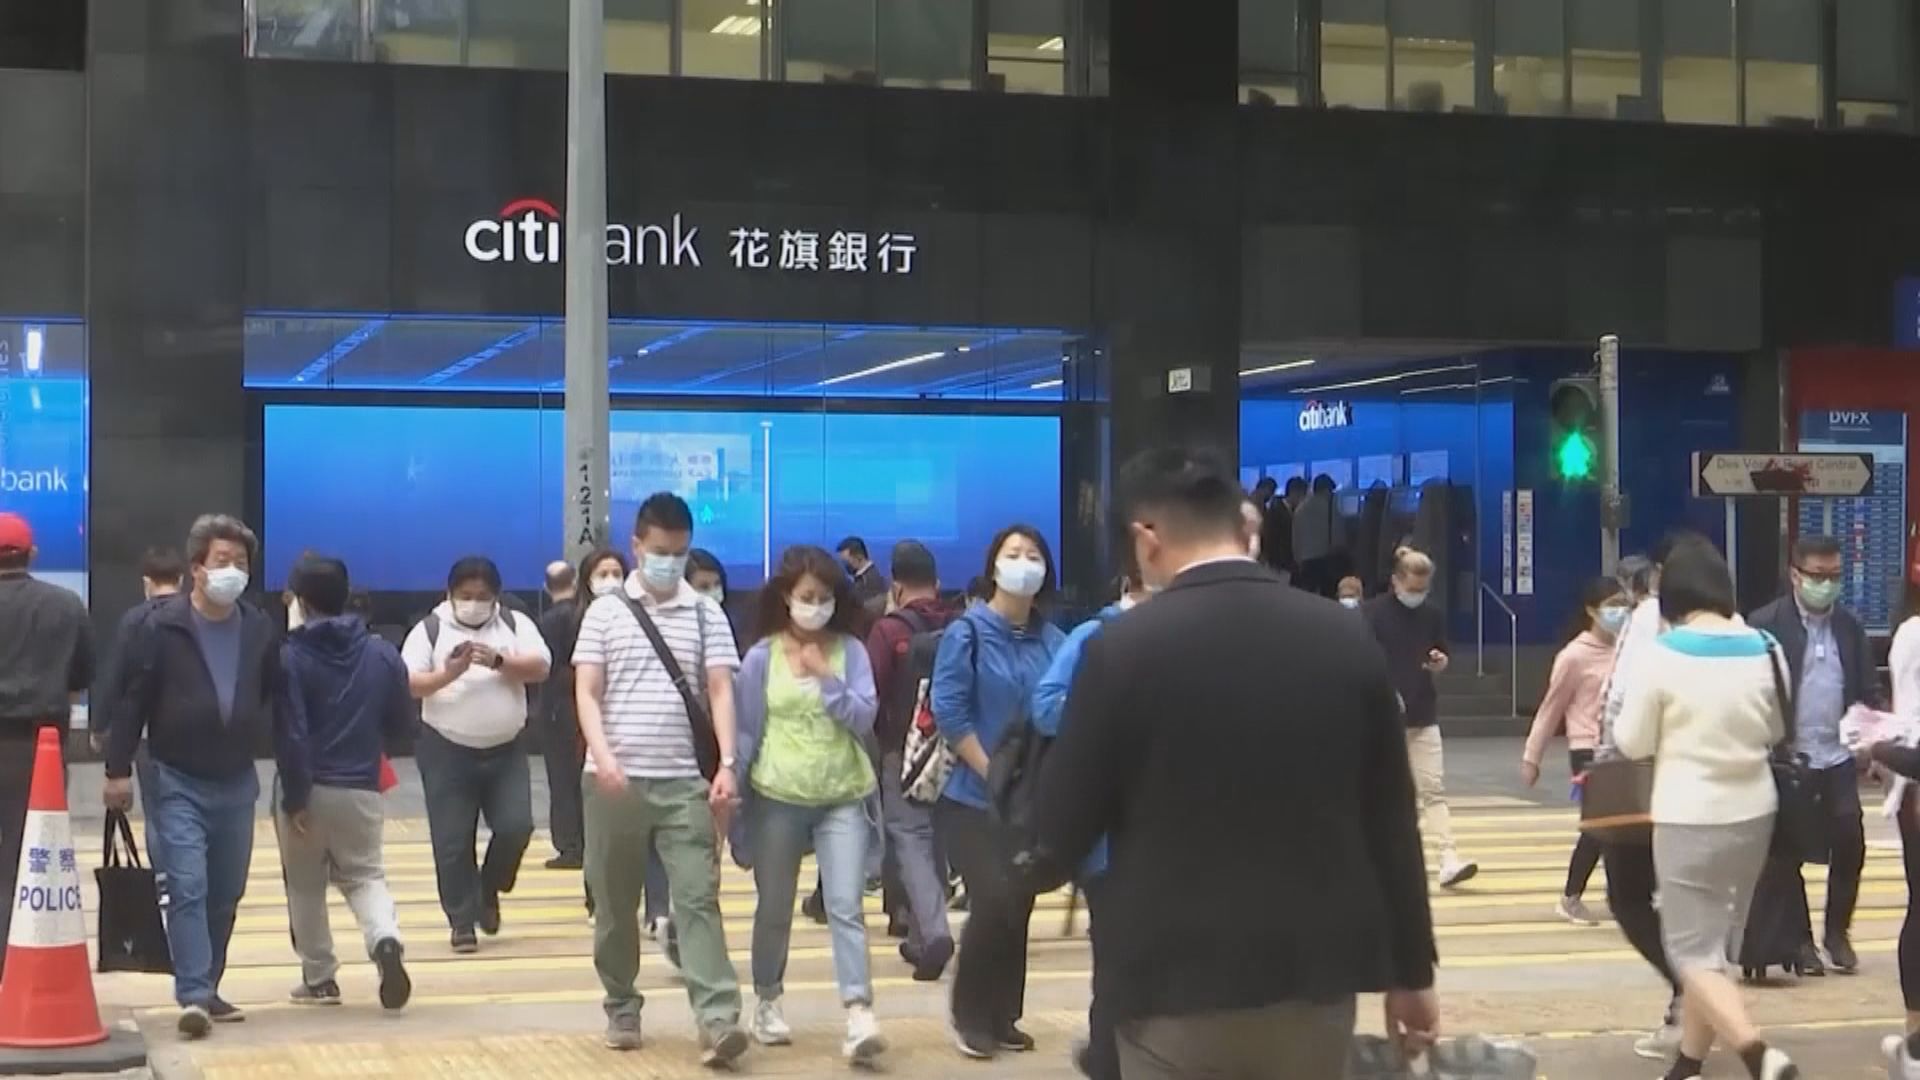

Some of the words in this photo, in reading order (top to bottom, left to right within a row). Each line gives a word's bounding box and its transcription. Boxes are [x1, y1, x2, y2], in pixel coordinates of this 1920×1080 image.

[464, 210, 701, 267] citiank
[729, 227, 917, 274] 花旗銀行
[1299, 400, 1348, 431] citibank
[1783, 457, 1813, 472] Rd
[29, 848, 76, 873] 警察
